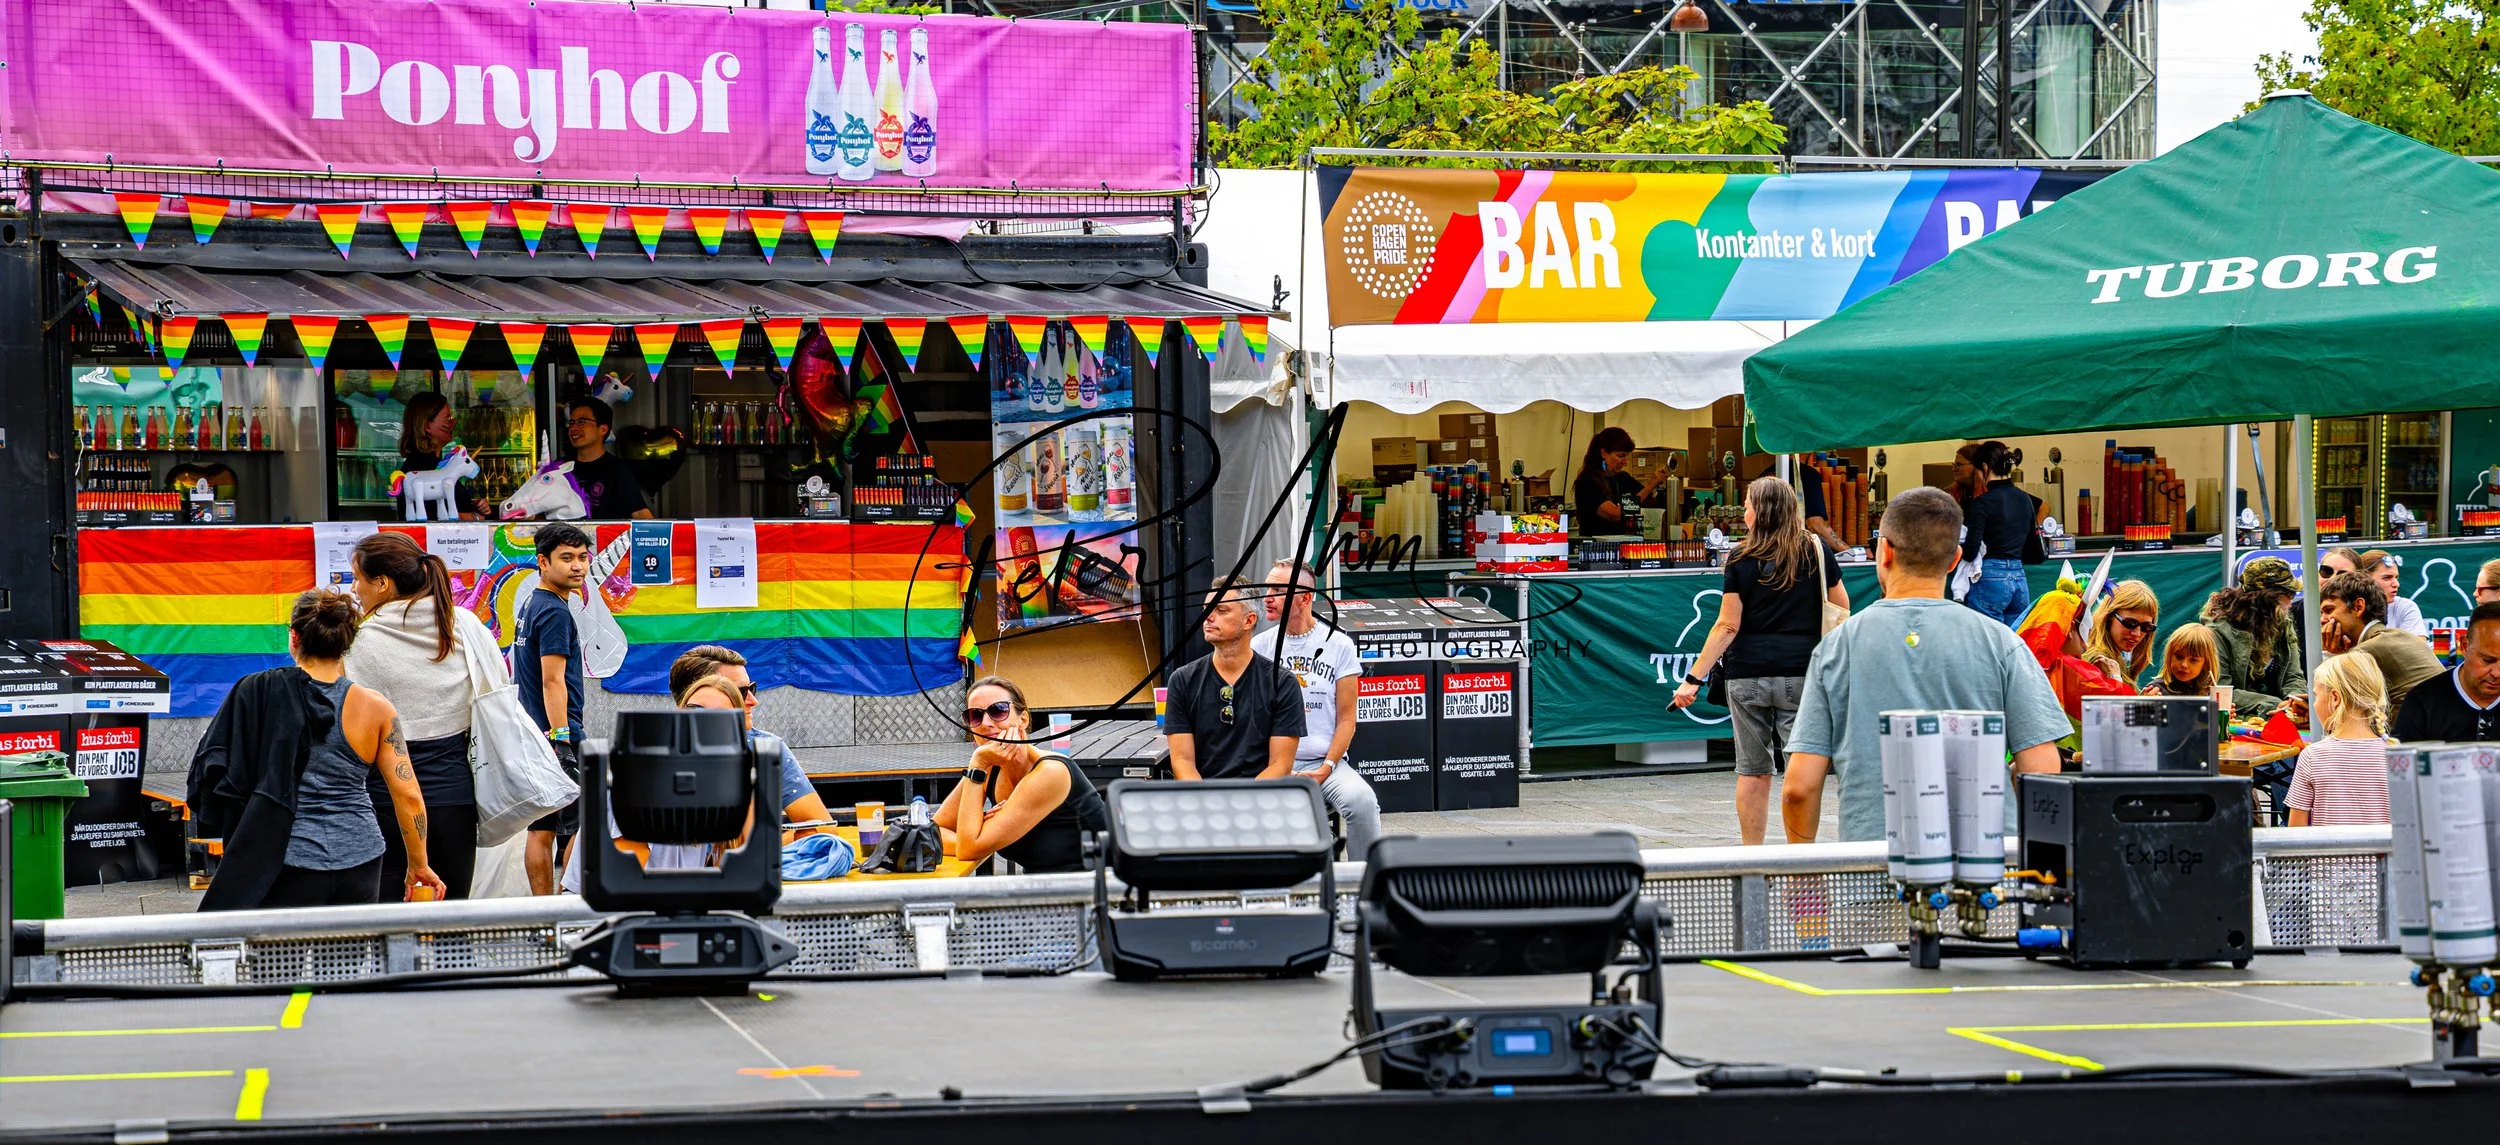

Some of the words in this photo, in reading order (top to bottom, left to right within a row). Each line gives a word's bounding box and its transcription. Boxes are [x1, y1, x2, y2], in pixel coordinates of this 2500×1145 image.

[310, 39, 740, 163] Ponyhof
[841, 136, 870, 146] Ponyhof
[906, 135, 933, 145] Ponyhof
[1372, 224, 1406, 237] COPEN
[1372, 237, 1407, 250] HAGEN
[1478, 201, 1622, 288] BAR
[1695, 228, 1805, 259] Kontanter
[1811, 227, 1827, 258] &
[1831, 227, 1876, 258] kort
[1374, 250, 1408, 264] PRIDE
[2085, 245, 2438, 304] TUBORG
[447, 538, 479, 546] betalingskort
[659, 537, 669, 546] ID
[645, 557, 657, 567] 18
[1286, 656, 1336, 684] STRENGTH
[41, 681, 58, 691] DÅSER
[96, 681, 132, 689] PLASTFLASKER
[140, 680, 156, 689] DÅSER
[1360, 680, 1385, 693] hus
[1386, 678, 1421, 691] forbi
[1448, 677, 1472, 689] hus
[1472, 675, 1507, 688] forbi
[1306, 702, 1323, 710] ROAD
[1358, 698, 1370, 709] DIN
[1372, 697, 1391, 708] PANT
[1446, 695, 1458, 706] DIN
[1460, 694, 1478, 704] PANT
[1480, 693, 1510, 714] JOB
[1358, 709, 1368, 719] ER
[1369, 708, 1392, 719] VORES
[1393, 696, 1423, 718] JOB
[1446, 706, 1454, 716] ER
[1456, 705, 1478, 715] VORES
[14, 735, 55, 750] forbi
[81, 733, 104, 747] hus
[104, 731, 135, 744] forbi
[78, 753, 90, 765] DIN
[91, 752, 109, 764] PANT
[110, 751, 136, 775] JOB
[78, 766, 86, 777] ER
[87, 764, 108, 776] VORES
